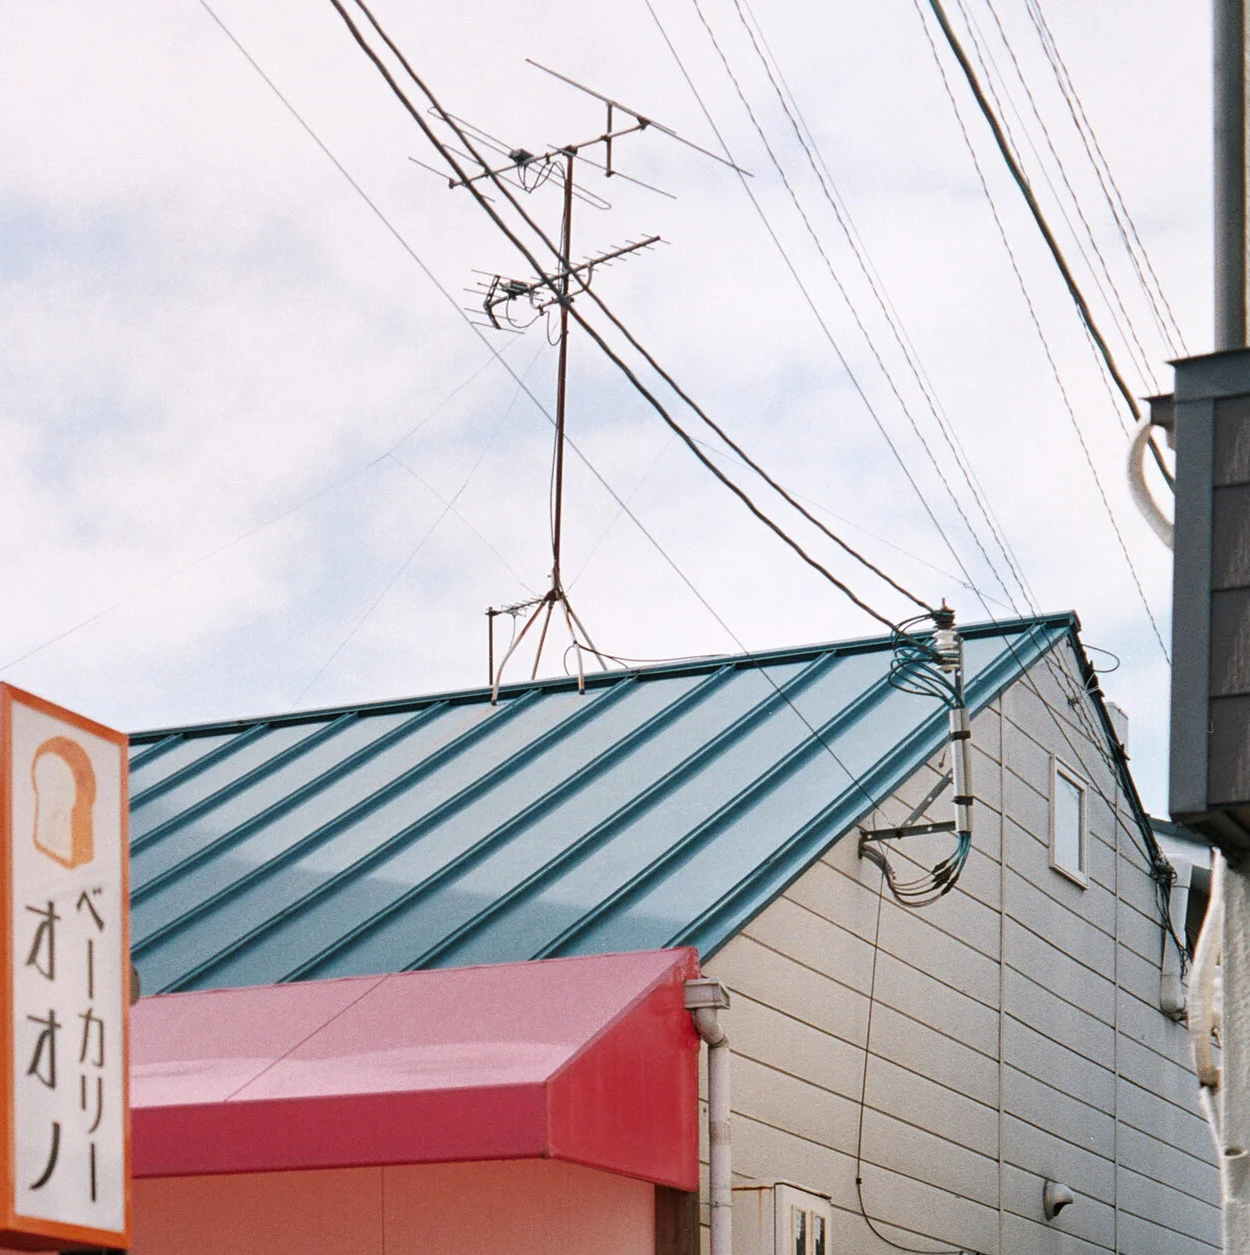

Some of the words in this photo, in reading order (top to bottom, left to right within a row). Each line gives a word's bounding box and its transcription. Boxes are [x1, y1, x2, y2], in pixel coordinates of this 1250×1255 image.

[25, 900, 62, 1190] オオノ
[77, 887, 105, 1203] ベーカリー
